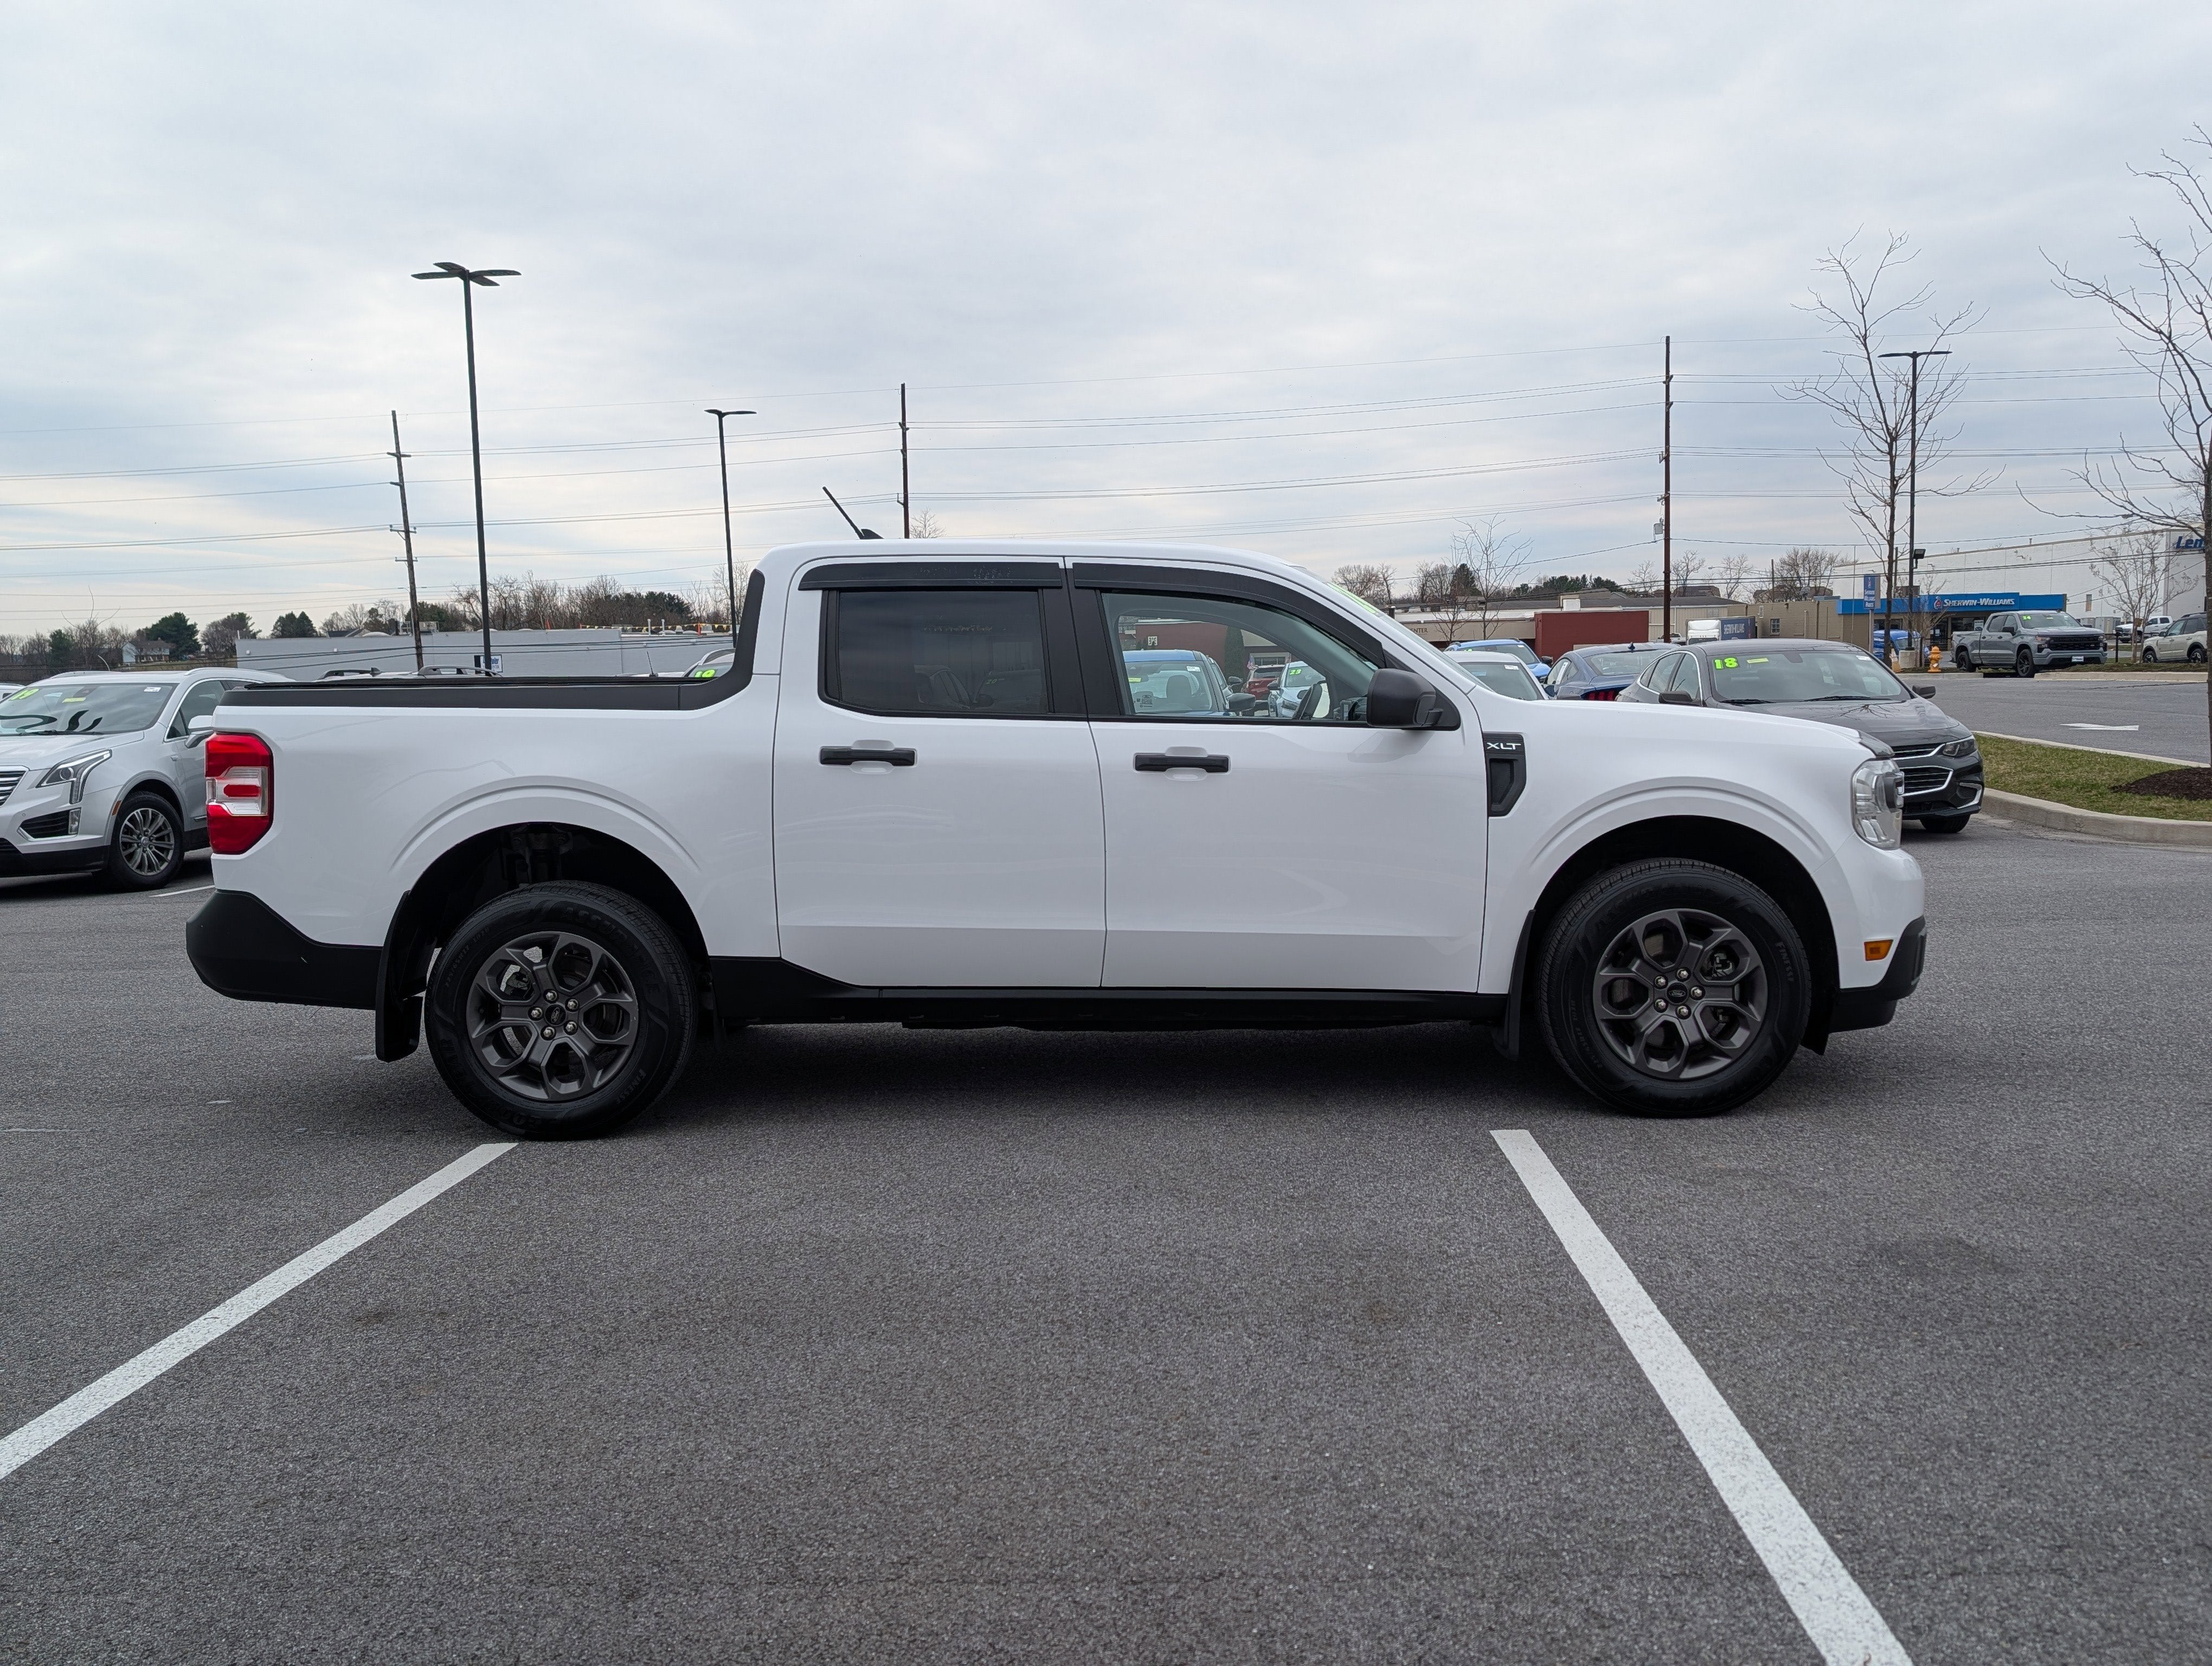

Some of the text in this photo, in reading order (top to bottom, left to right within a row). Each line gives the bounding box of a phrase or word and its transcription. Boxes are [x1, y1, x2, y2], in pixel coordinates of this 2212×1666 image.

[2176, 536, 2205, 549] Len
[1714, 658, 1739, 669] 18
[1486, 742, 1522, 750] XLT
